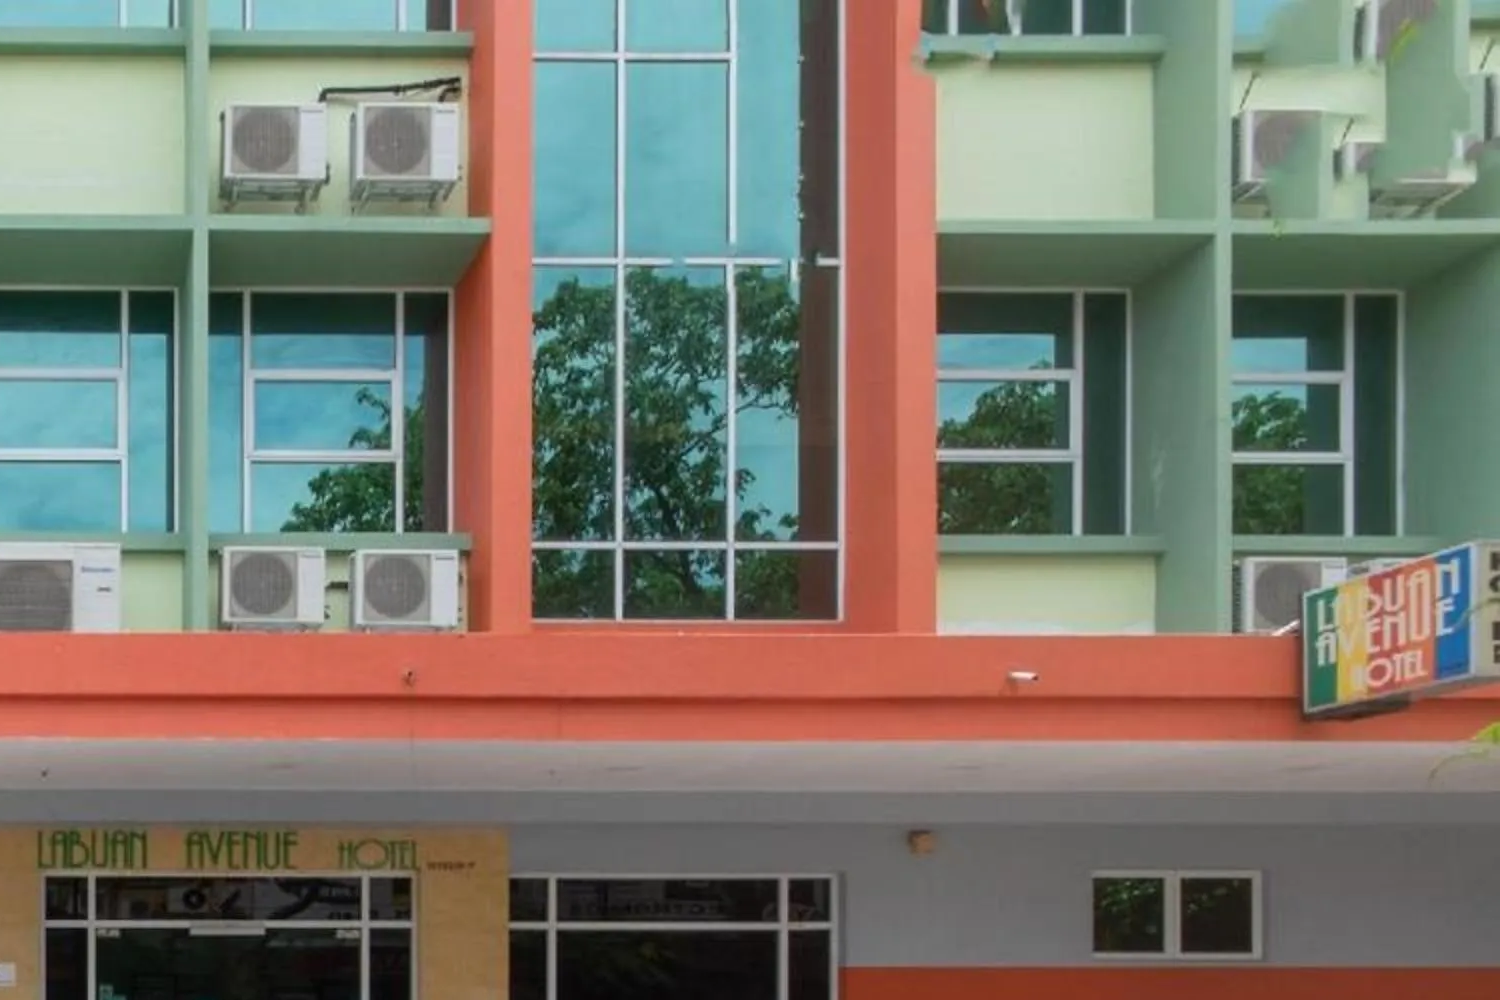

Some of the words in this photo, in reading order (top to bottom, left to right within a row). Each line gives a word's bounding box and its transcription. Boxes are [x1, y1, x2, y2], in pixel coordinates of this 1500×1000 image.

[37, 829, 147, 869] LABUAN
[185, 830, 299, 870] AVENUE
[338, 838, 420, 872] HOTEL
